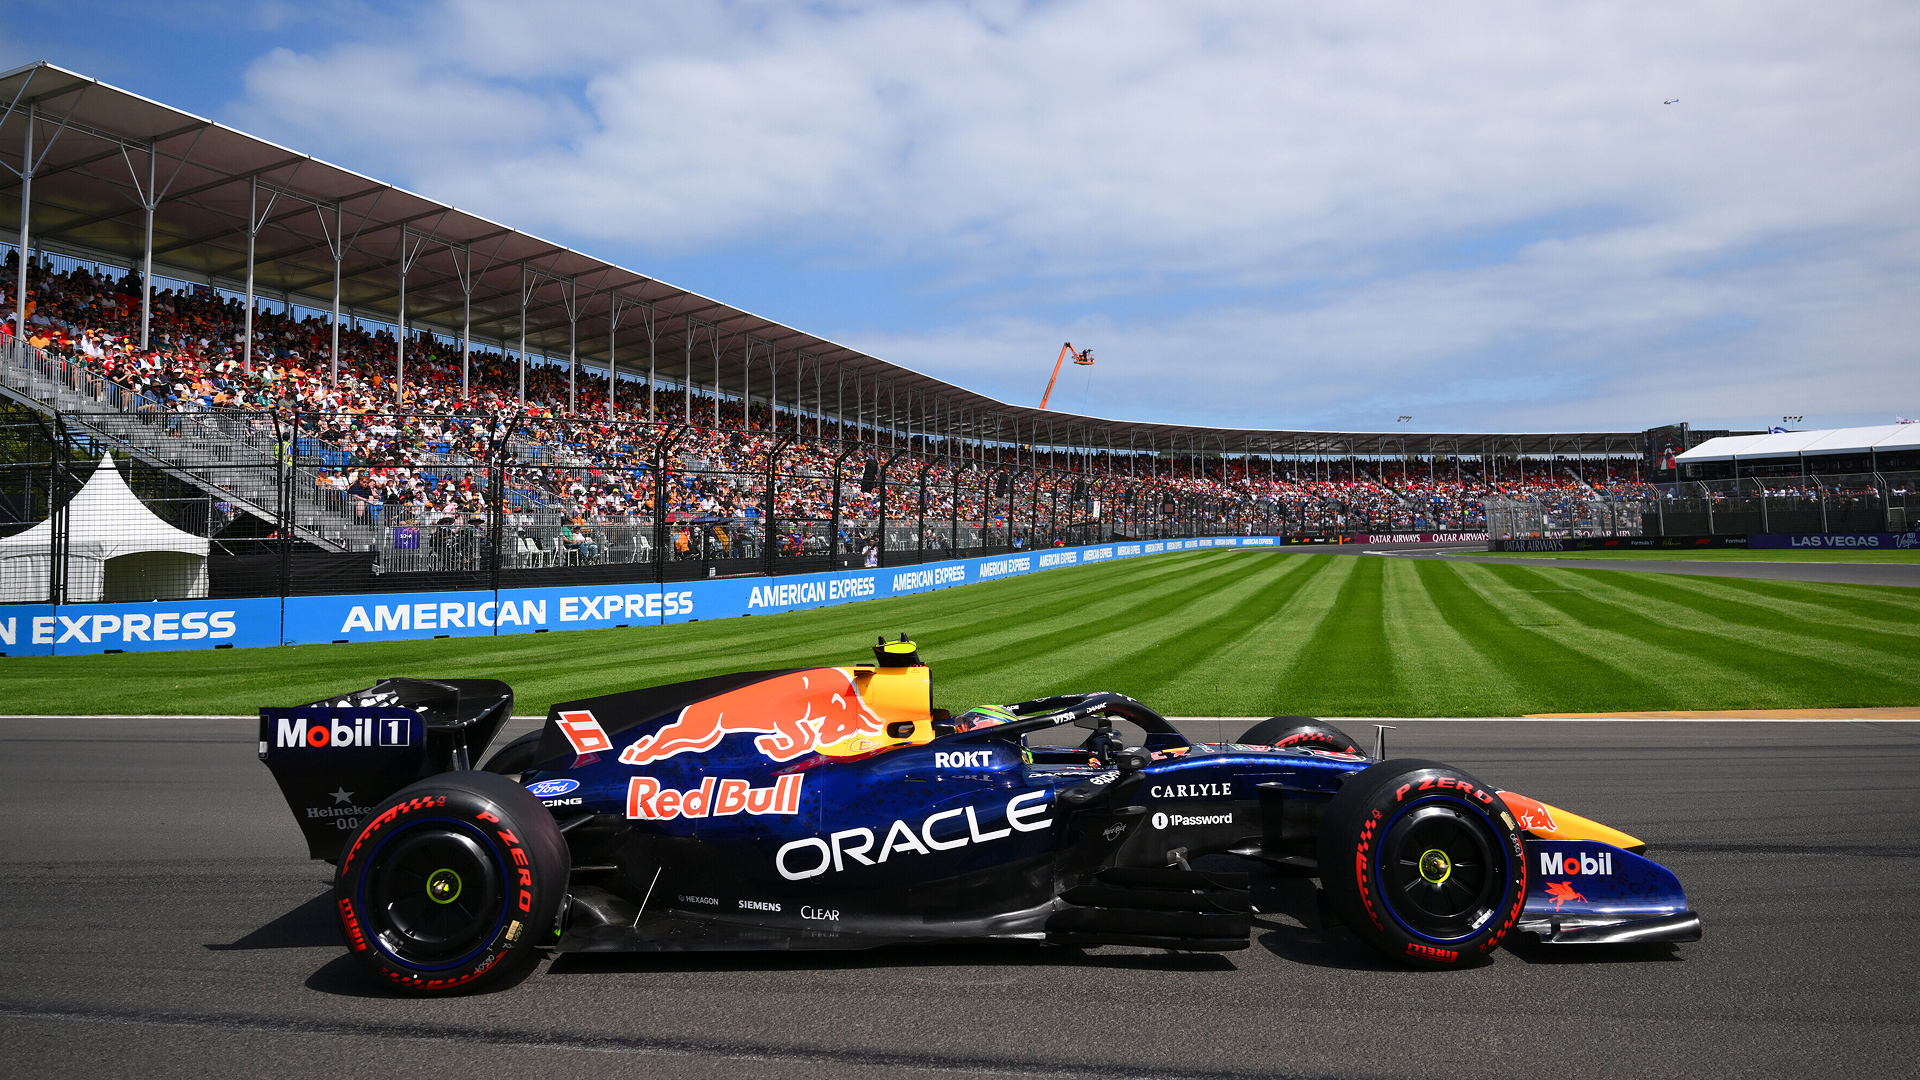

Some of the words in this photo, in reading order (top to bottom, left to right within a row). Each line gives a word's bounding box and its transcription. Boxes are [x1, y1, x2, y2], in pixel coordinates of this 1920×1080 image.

[1369, 535, 1391, 544] QATAR
[1392, 534, 1420, 543] AIRWAYS
[1432, 533, 1457, 542] QATAR
[1459, 533, 1489, 541] AIRWAYS
[1504, 540, 1526, 551] QATAR
[1527, 540, 1563, 551] AIRWAYS
[1791, 536, 1821, 546] LAS
[1824, 536, 1879, 546] VEGAS
[979, 560, 1007, 578] AMERICAN
[1009, 557, 1030, 572] EXPRESS
[893, 570, 933, 592] AMERICAN
[934, 565, 965, 586] EXPRESS
[748, 581, 826, 608] AMERICAN
[829, 577, 875, 599] EXPRESS
[340, 599, 546, 633] AMERICAN
[559, 591, 694, 622] EXPRESS
[32, 611, 236, 644] EXPRESS
[1087, 702, 1107, 714] DAMAC
[1052, 712, 1075, 724] VISA
[277, 718, 372, 747] Mobil
[555, 710, 613, 755] 6
[935, 751, 992, 768] ROKT
[533, 781, 569, 793] Ford
[1151, 783, 1231, 798] CARLYLE
[1396, 783, 1411, 801] P
[1418, 777, 1494, 804] ZERO
[542, 798, 582, 807] CING
[626, 776, 717, 820] Red
[713, 773, 804, 816] Bull
[306, 805, 375, 818] Heineke
[1170, 813, 1232, 826] 1Password
[775, 789, 1054, 881] ORACLE
[476, 811, 499, 823] P
[497, 829, 532, 913] ZERO
[1540, 852, 1612, 875] Mobil
[685, 895, 719, 905] HEXAGON
[738, 900, 781, 912] SIEMENS
[800, 905, 840, 921] CLEAR
[339, 898, 367, 952] PIRELLI
[1405, 943, 1458, 962] PIRELLI
